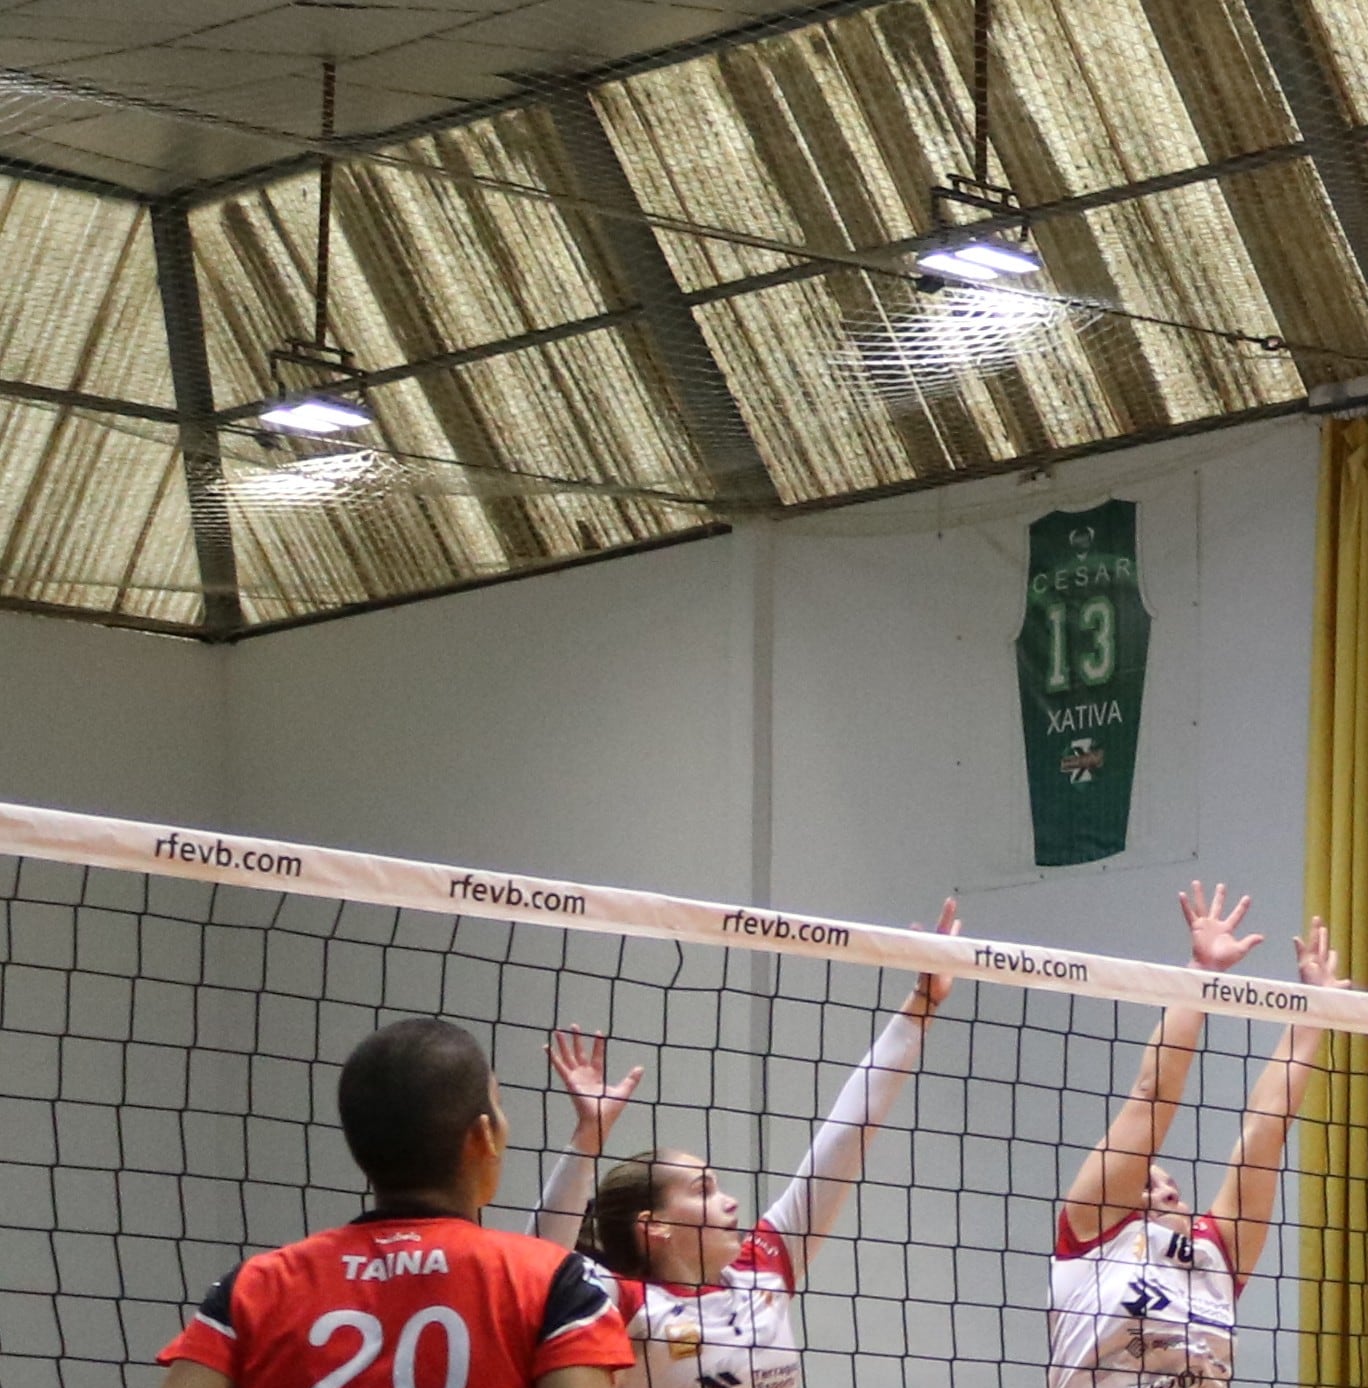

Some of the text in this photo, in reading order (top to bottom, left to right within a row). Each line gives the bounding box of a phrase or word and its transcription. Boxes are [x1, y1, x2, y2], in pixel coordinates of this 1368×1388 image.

[1033, 557, 1131, 594] CESAR
[1046, 596, 1116, 694] 13
[1047, 700, 1123, 735] XATIVA
[155, 833, 302, 877] rfevb.com
[450, 874, 586, 915] rfevb.com
[722, 910, 850, 946] rfevb.com
[974, 947, 1088, 981] rfevb.com
[1201, 979, 1308, 1012] rfevb.com
[341, 1249, 449, 1282] TAINA
